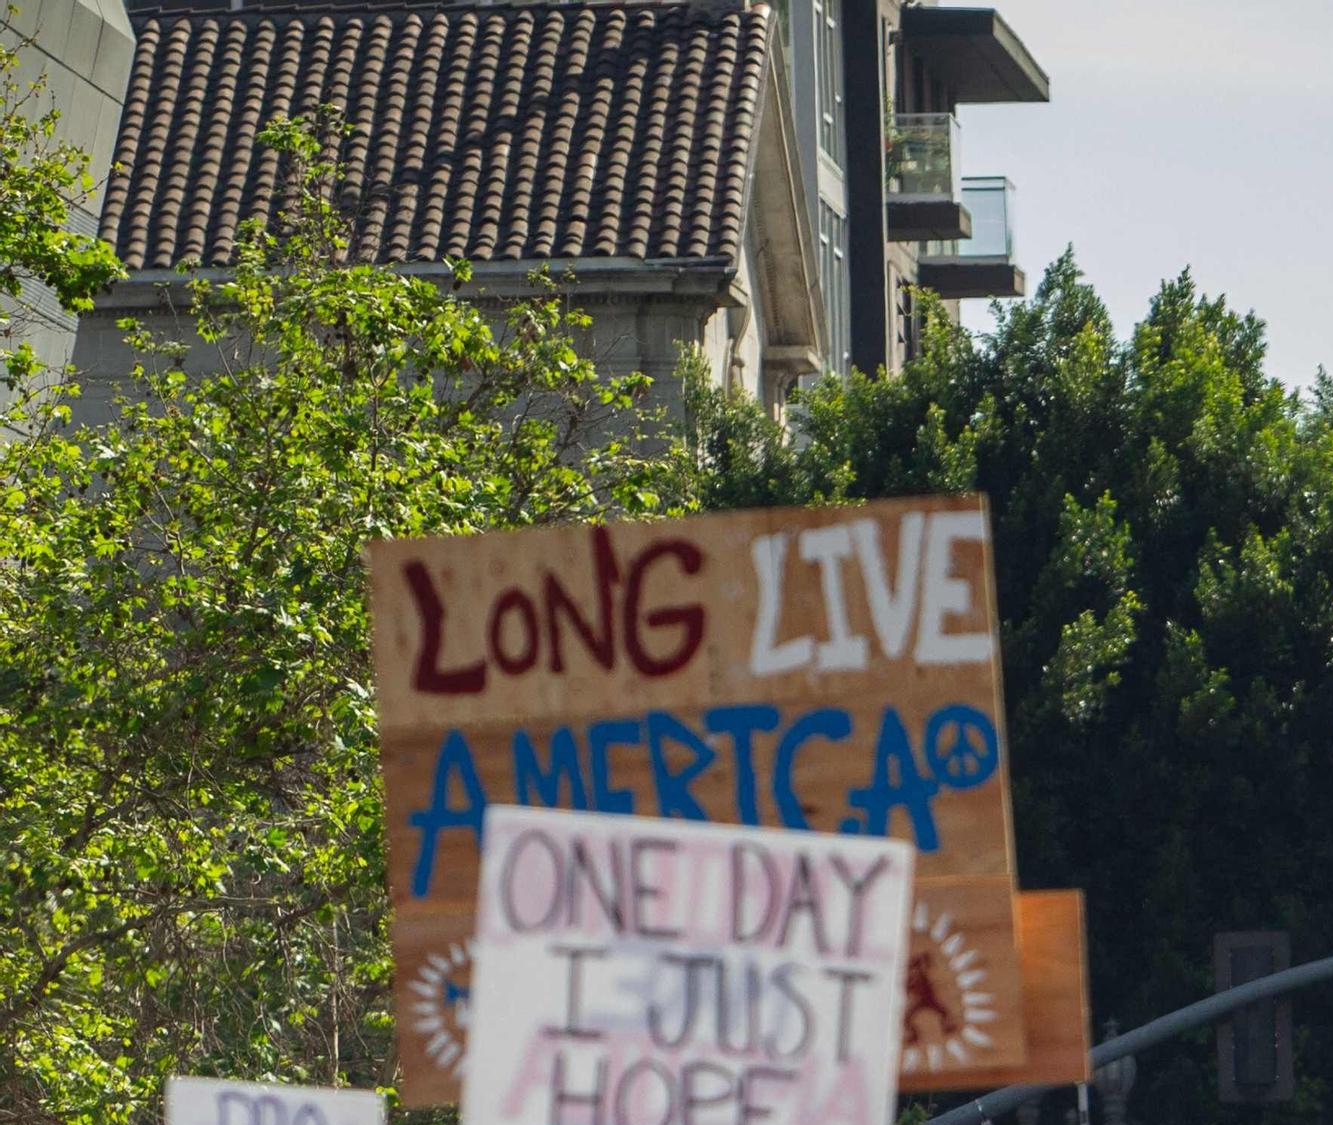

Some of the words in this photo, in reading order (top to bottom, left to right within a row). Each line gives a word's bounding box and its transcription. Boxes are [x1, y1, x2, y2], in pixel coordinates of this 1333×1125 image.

[406, 524, 707, 694] LONG
[750, 510, 997, 677] LIVE
[502, 829, 685, 939] ONE
[730, 844, 890, 960] DAY
[548, 945, 610, 1041] I
[648, 953, 873, 1066] JUST
